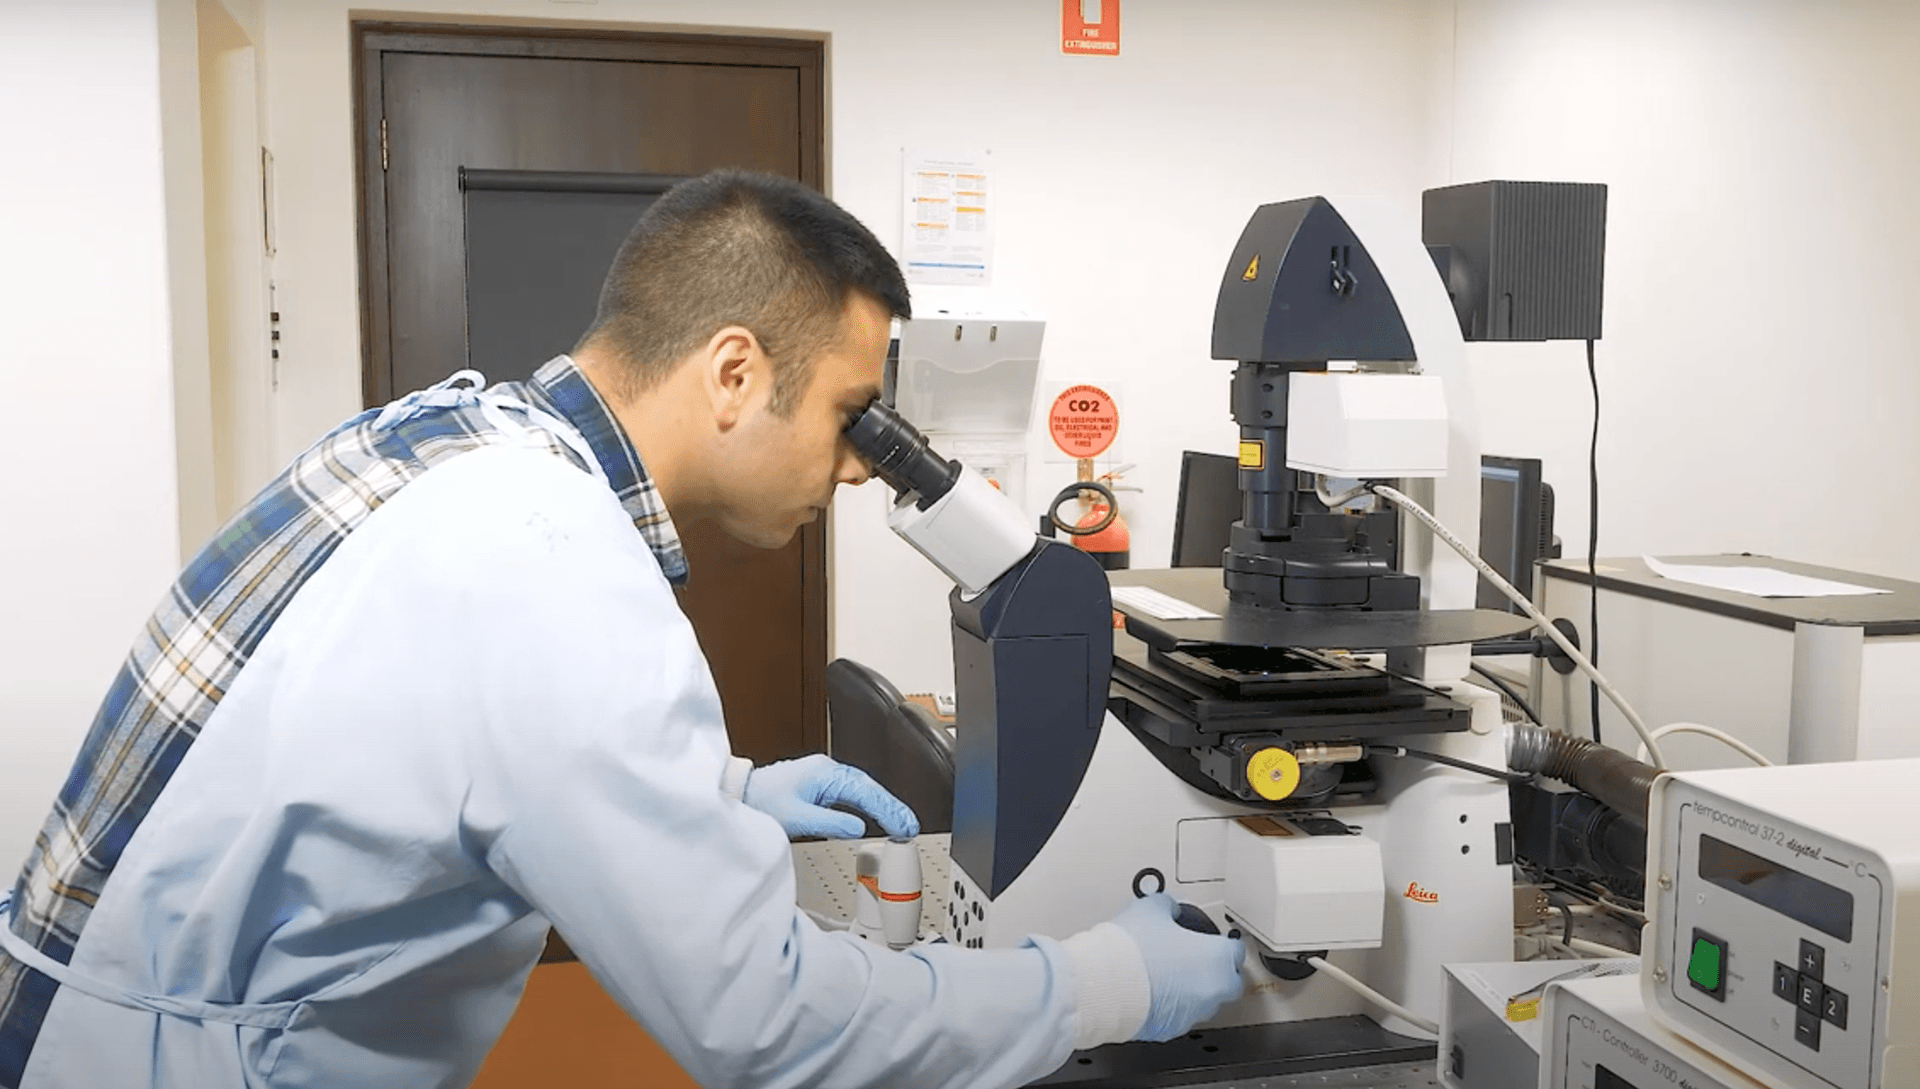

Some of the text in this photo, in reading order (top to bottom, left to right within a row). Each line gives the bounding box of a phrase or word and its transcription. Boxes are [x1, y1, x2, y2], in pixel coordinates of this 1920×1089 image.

[1069, 399, 1100, 413] CO2
[1693, 801, 1822, 860] tempcontrol 37-2 digital
[1403, 881, 1439, 903] Leica
[1779, 975, 1836, 1017] 1 E 2
[1653, 1060, 1677, 1083] 3700
